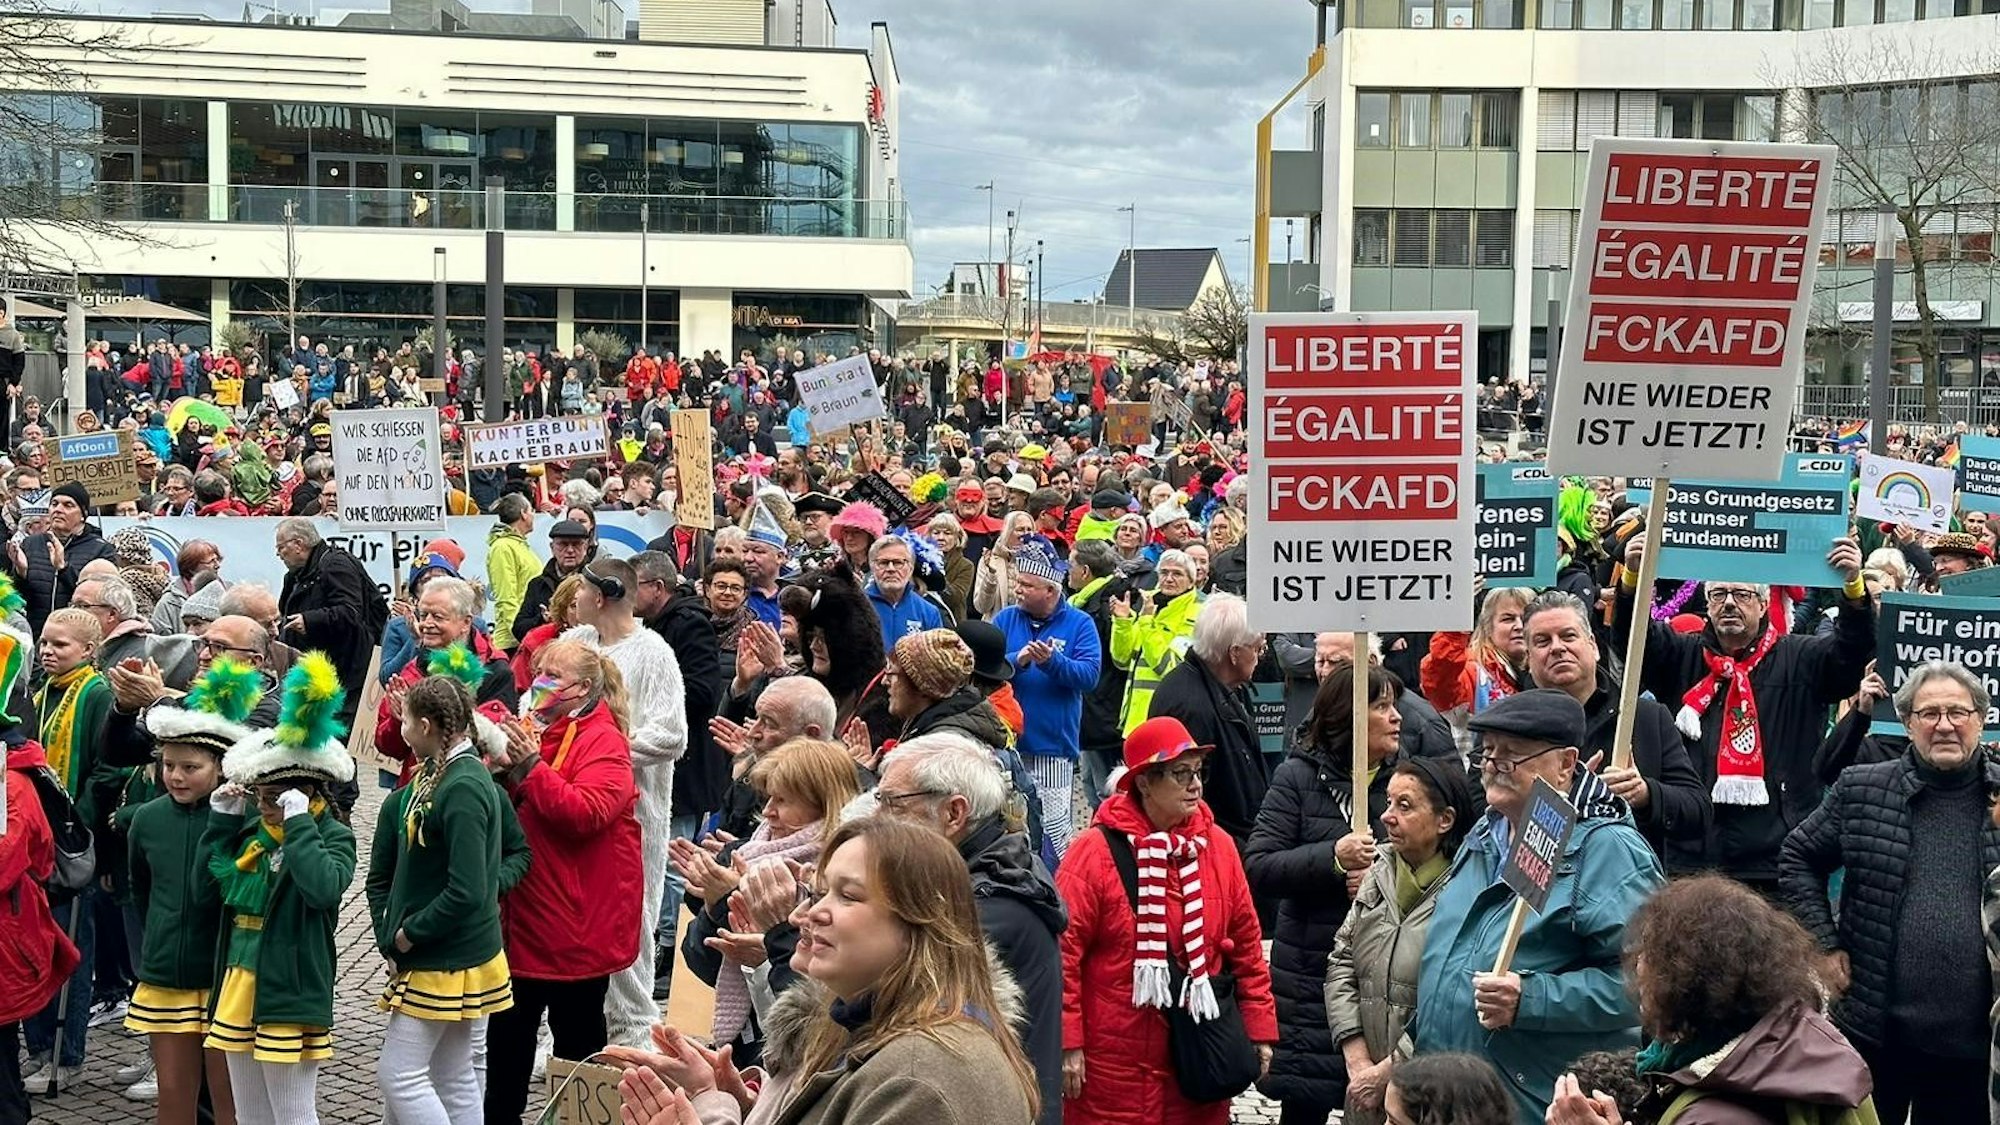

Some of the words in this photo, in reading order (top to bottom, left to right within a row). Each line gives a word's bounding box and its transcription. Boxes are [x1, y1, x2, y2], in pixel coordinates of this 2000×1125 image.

[1606, 160, 1817, 211] LIBERTÉ
[1594, 230, 1804, 284] ÉGALITÉ
[1587, 315, 1786, 356] FCKAFD
[1267, 325, 1461, 373] LIBERTÉ
[821, 395, 859, 414] Braun
[1583, 382, 1637, 407] NIE
[1646, 384, 1772, 410] WIEDER
[342, 423, 367, 438] WIR
[371, 421, 425, 438] SCHIESSEN
[1266, 394, 1461, 442] ÉGALITÉ
[472, 419, 602, 443] KUNTERBUNT
[526, 436, 550, 445] STATT
[1577, 418, 1634, 446] IST
[1642, 420, 1766, 450] JETZT!
[357, 447, 372, 462] DIE
[376, 447, 398, 467] AfD
[474, 438, 605, 464] KACKEBRAUN
[54, 458, 135, 482] DEMOKRATIE
[1810, 460, 1844, 471] CDU
[1965, 458, 1987, 470] Das
[1965, 470, 1980, 481] ist
[344, 474, 362, 490] AUF
[367, 474, 389, 490] DEN
[1270, 475, 1457, 511] FCKAFD
[1666, 487, 1700, 504] Das
[1704, 490, 1835, 512] Grundgesetz
[344, 506, 369, 522] OHNE
[1475, 503, 1544, 524] fenes
[1663, 508, 1687, 524] ist
[1691, 512, 1748, 528] unser
[1475, 527, 1527, 549] ein-
[1661, 527, 1779, 549] Fundament!
[1274, 540, 1323, 563] NIE
[1332, 539, 1453, 563] WIEDER
[1273, 576, 1326, 602] IST
[1334, 574, 1452, 601] JETZT!
[1897, 610, 1949, 637] Für
